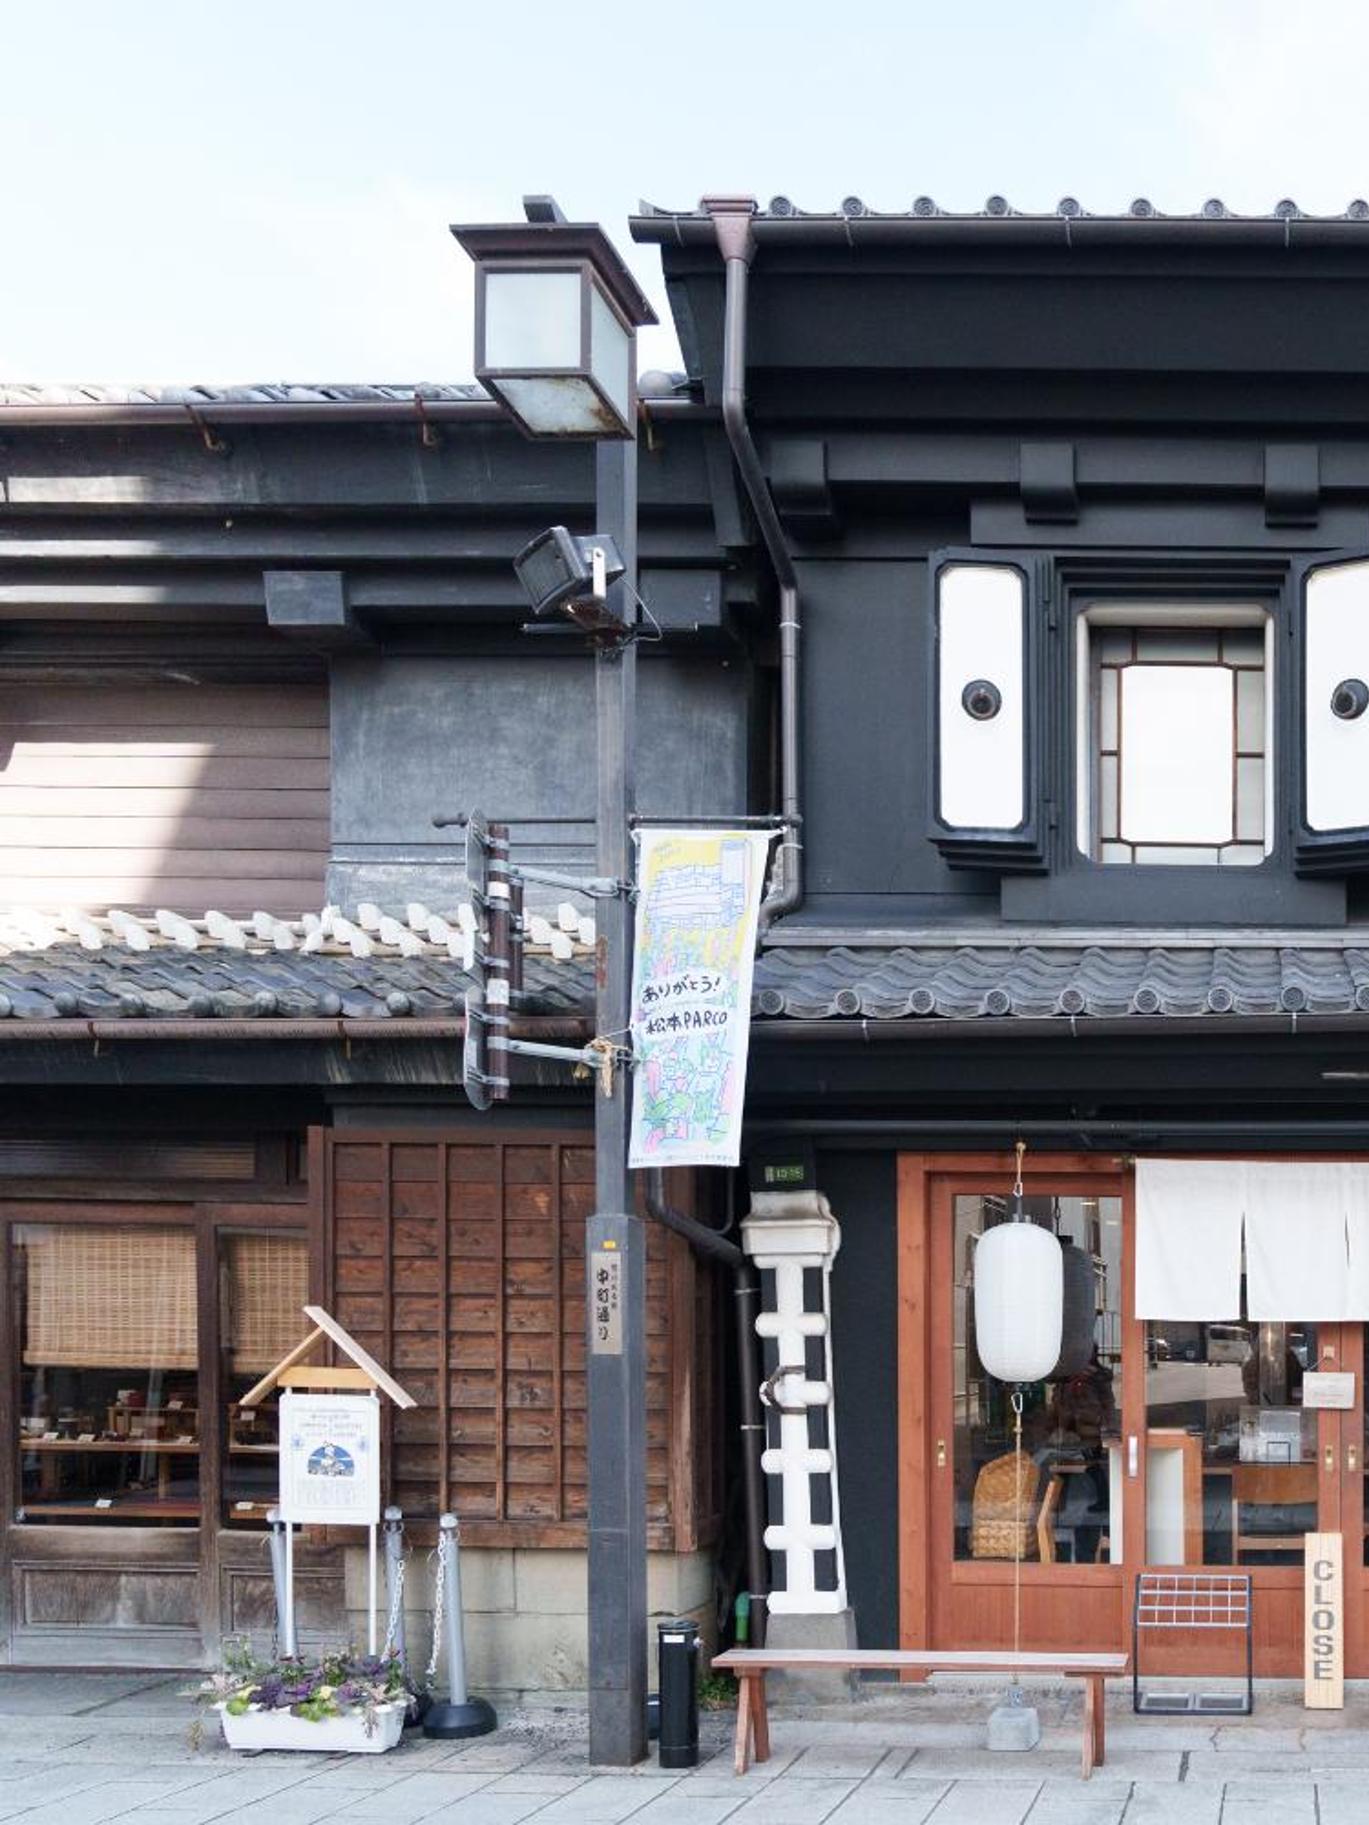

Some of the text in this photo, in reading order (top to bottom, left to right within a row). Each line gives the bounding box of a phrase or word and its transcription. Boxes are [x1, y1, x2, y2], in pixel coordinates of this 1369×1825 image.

[646, 1010, 728, 1035] 松本PARCO
[596, 1268, 610, 1341] 中町通り
[1311, 1560, 1335, 1680] CLOSE
